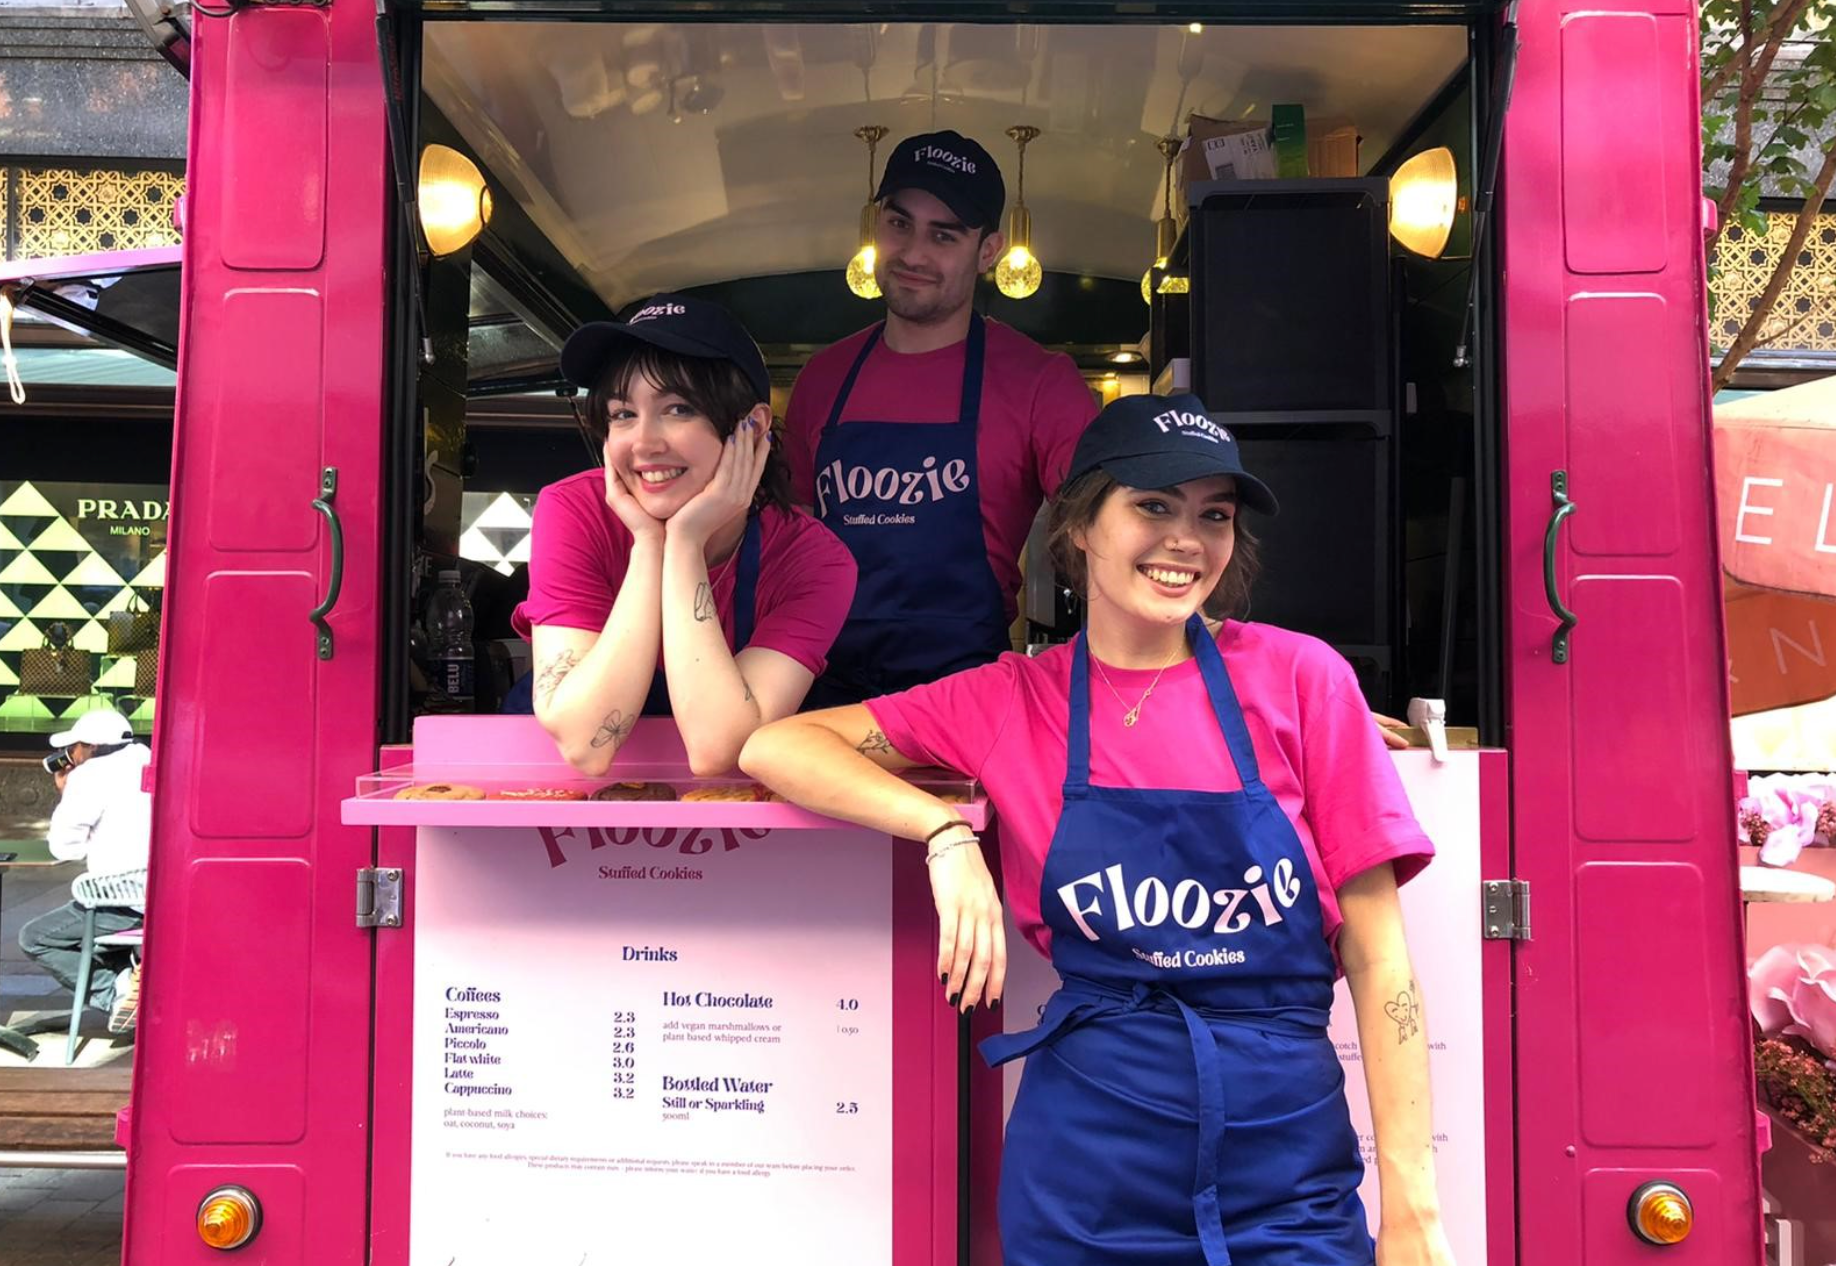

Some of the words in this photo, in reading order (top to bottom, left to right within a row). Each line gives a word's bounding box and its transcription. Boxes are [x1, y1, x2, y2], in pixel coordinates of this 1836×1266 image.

[914, 145, 976, 174] Floozie
[816, 456, 970, 519] Floozie
[844, 514, 875, 526] Stuffed
[877, 514, 915, 524] Cookies
[110, 526, 150, 536] MILANO
[447, 664, 460, 693] BELU
[598, 866, 646, 880] Stuffed
[650, 866, 703, 880] Cookies
[1057, 858, 1300, 941] Floozie
[622, 946, 677, 961] Drinks
[1184, 948, 1245, 967] Cookies
[445, 987, 501, 1002] Coffees
[663, 992, 691, 1007] Hot
[695, 992, 773, 1008] Chocolate
[836, 999, 858, 1010] 4.0
[445, 1008, 499, 1021] Espresso
[614, 1012, 636, 1023] 2.3
[445, 1023, 509, 1035] Americano
[614, 1027, 636, 1038] 2.3
[663, 1021, 678, 1029] add
[681, 1023, 705, 1032] vegan
[708, 1022, 770, 1031] marshmallows
[445, 1038, 487, 1049] Piccolo
[663, 1032, 684, 1042] plant
[687, 1033, 711, 1041] based
[714, 1034, 752, 1044] whipped
[613, 1042, 634, 1053] 2.6
[1335, 1042, 1358, 1050] cotch
[1428, 1042, 1446, 1050] with
[445, 1052, 467, 1064] Flat
[470, 1053, 501, 1065] white
[613, 1057, 635, 1069] 3.0
[1339, 1053, 1362, 1061] stuffe
[445, 1067, 474, 1079] Latte
[613, 1072, 634, 1084] 3.2
[444, 1082, 512, 1096] Cappuccino
[662, 1076, 719, 1091] Bottled
[722, 1077, 773, 1093] Water
[613, 1087, 634, 1099] 3.2
[662, 1097, 686, 1109] Still
[689, 1100, 703, 1109] or
[705, 1098, 764, 1113] Sparkling
[836, 1102, 858, 1114] 2.5
[495, 1109, 513, 1117] milk
[662, 1112, 690, 1122] 500ml
[444, 1120, 458, 1128] oat,
[460, 1121, 495, 1129] coconut,
[497, 1122, 515, 1131] soya
